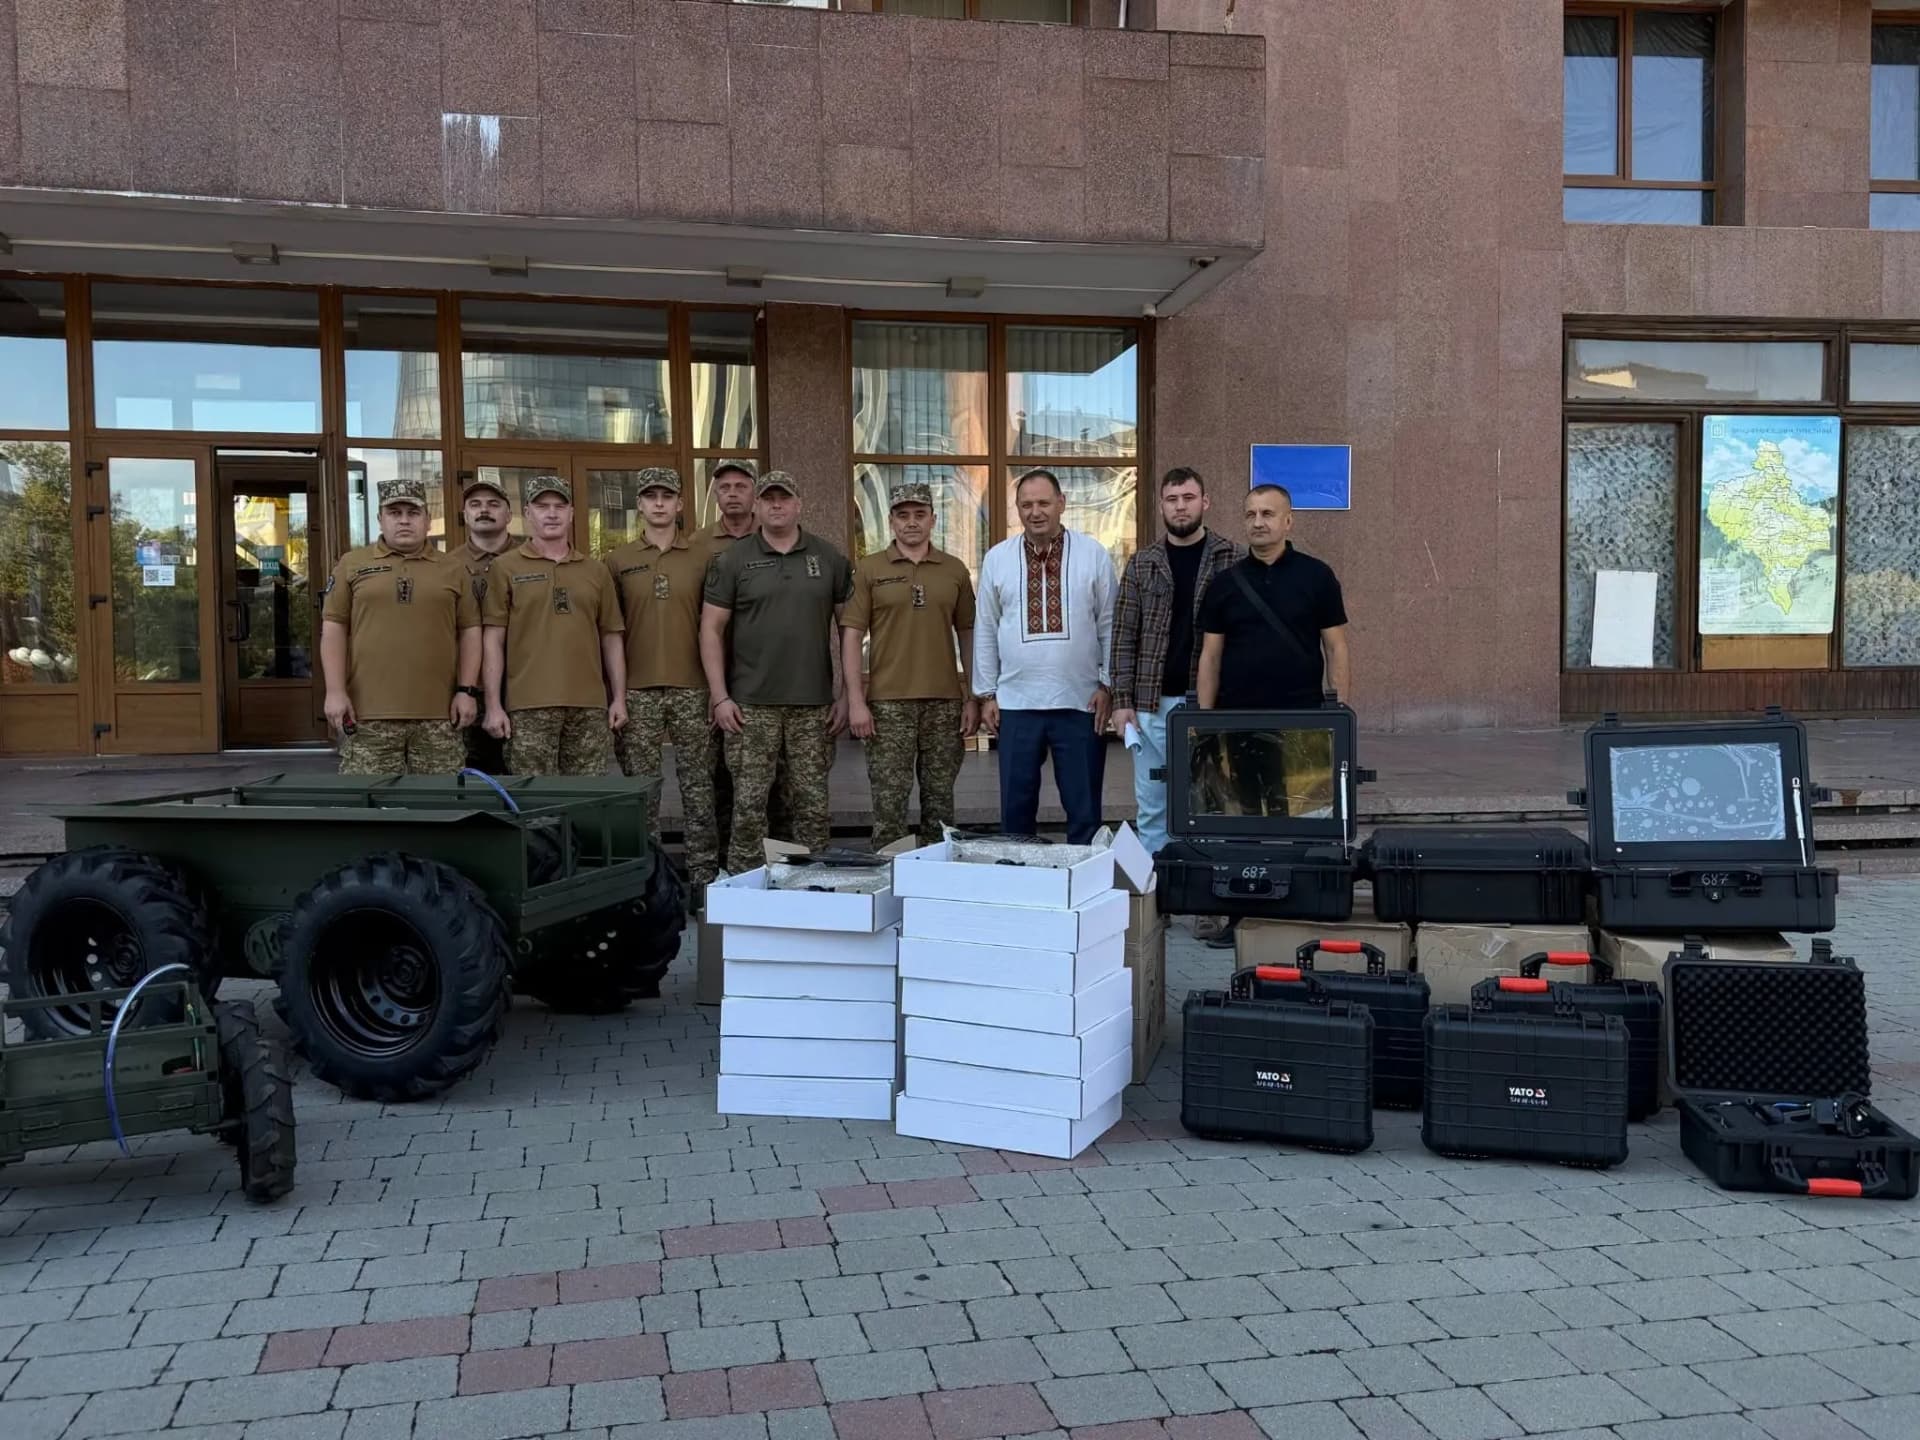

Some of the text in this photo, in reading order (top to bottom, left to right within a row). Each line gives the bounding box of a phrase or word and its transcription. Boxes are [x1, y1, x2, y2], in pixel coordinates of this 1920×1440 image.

[1242, 866, 1268, 879] 687
[1701, 873, 1729, 886] 687
[1256, 1071, 1280, 1081] YATO
[1509, 1087, 1534, 1097] YATO
